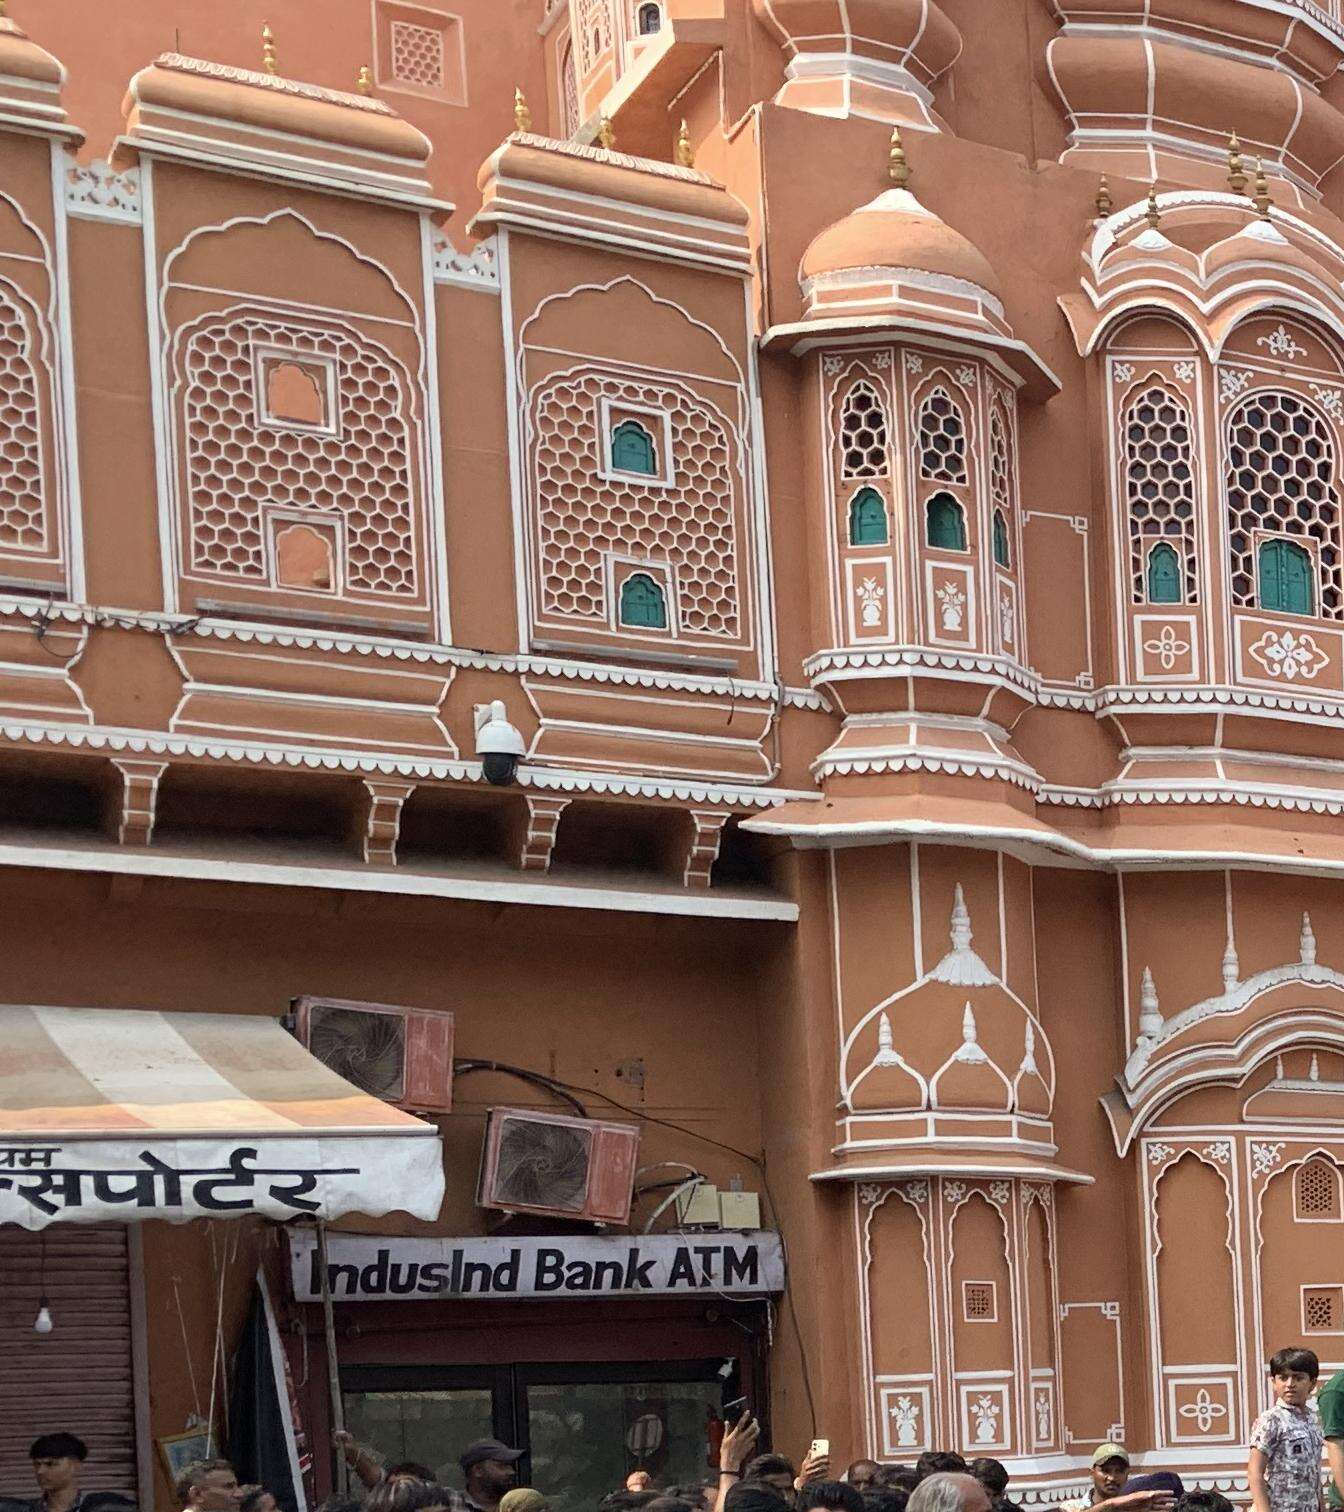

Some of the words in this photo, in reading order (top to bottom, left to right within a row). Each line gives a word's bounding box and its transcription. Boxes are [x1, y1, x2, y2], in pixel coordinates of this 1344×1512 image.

[311, 1248, 521, 1294] IndusInd
[535, 1248, 658, 1292] Bank
[668, 1245, 759, 1287] ATM
